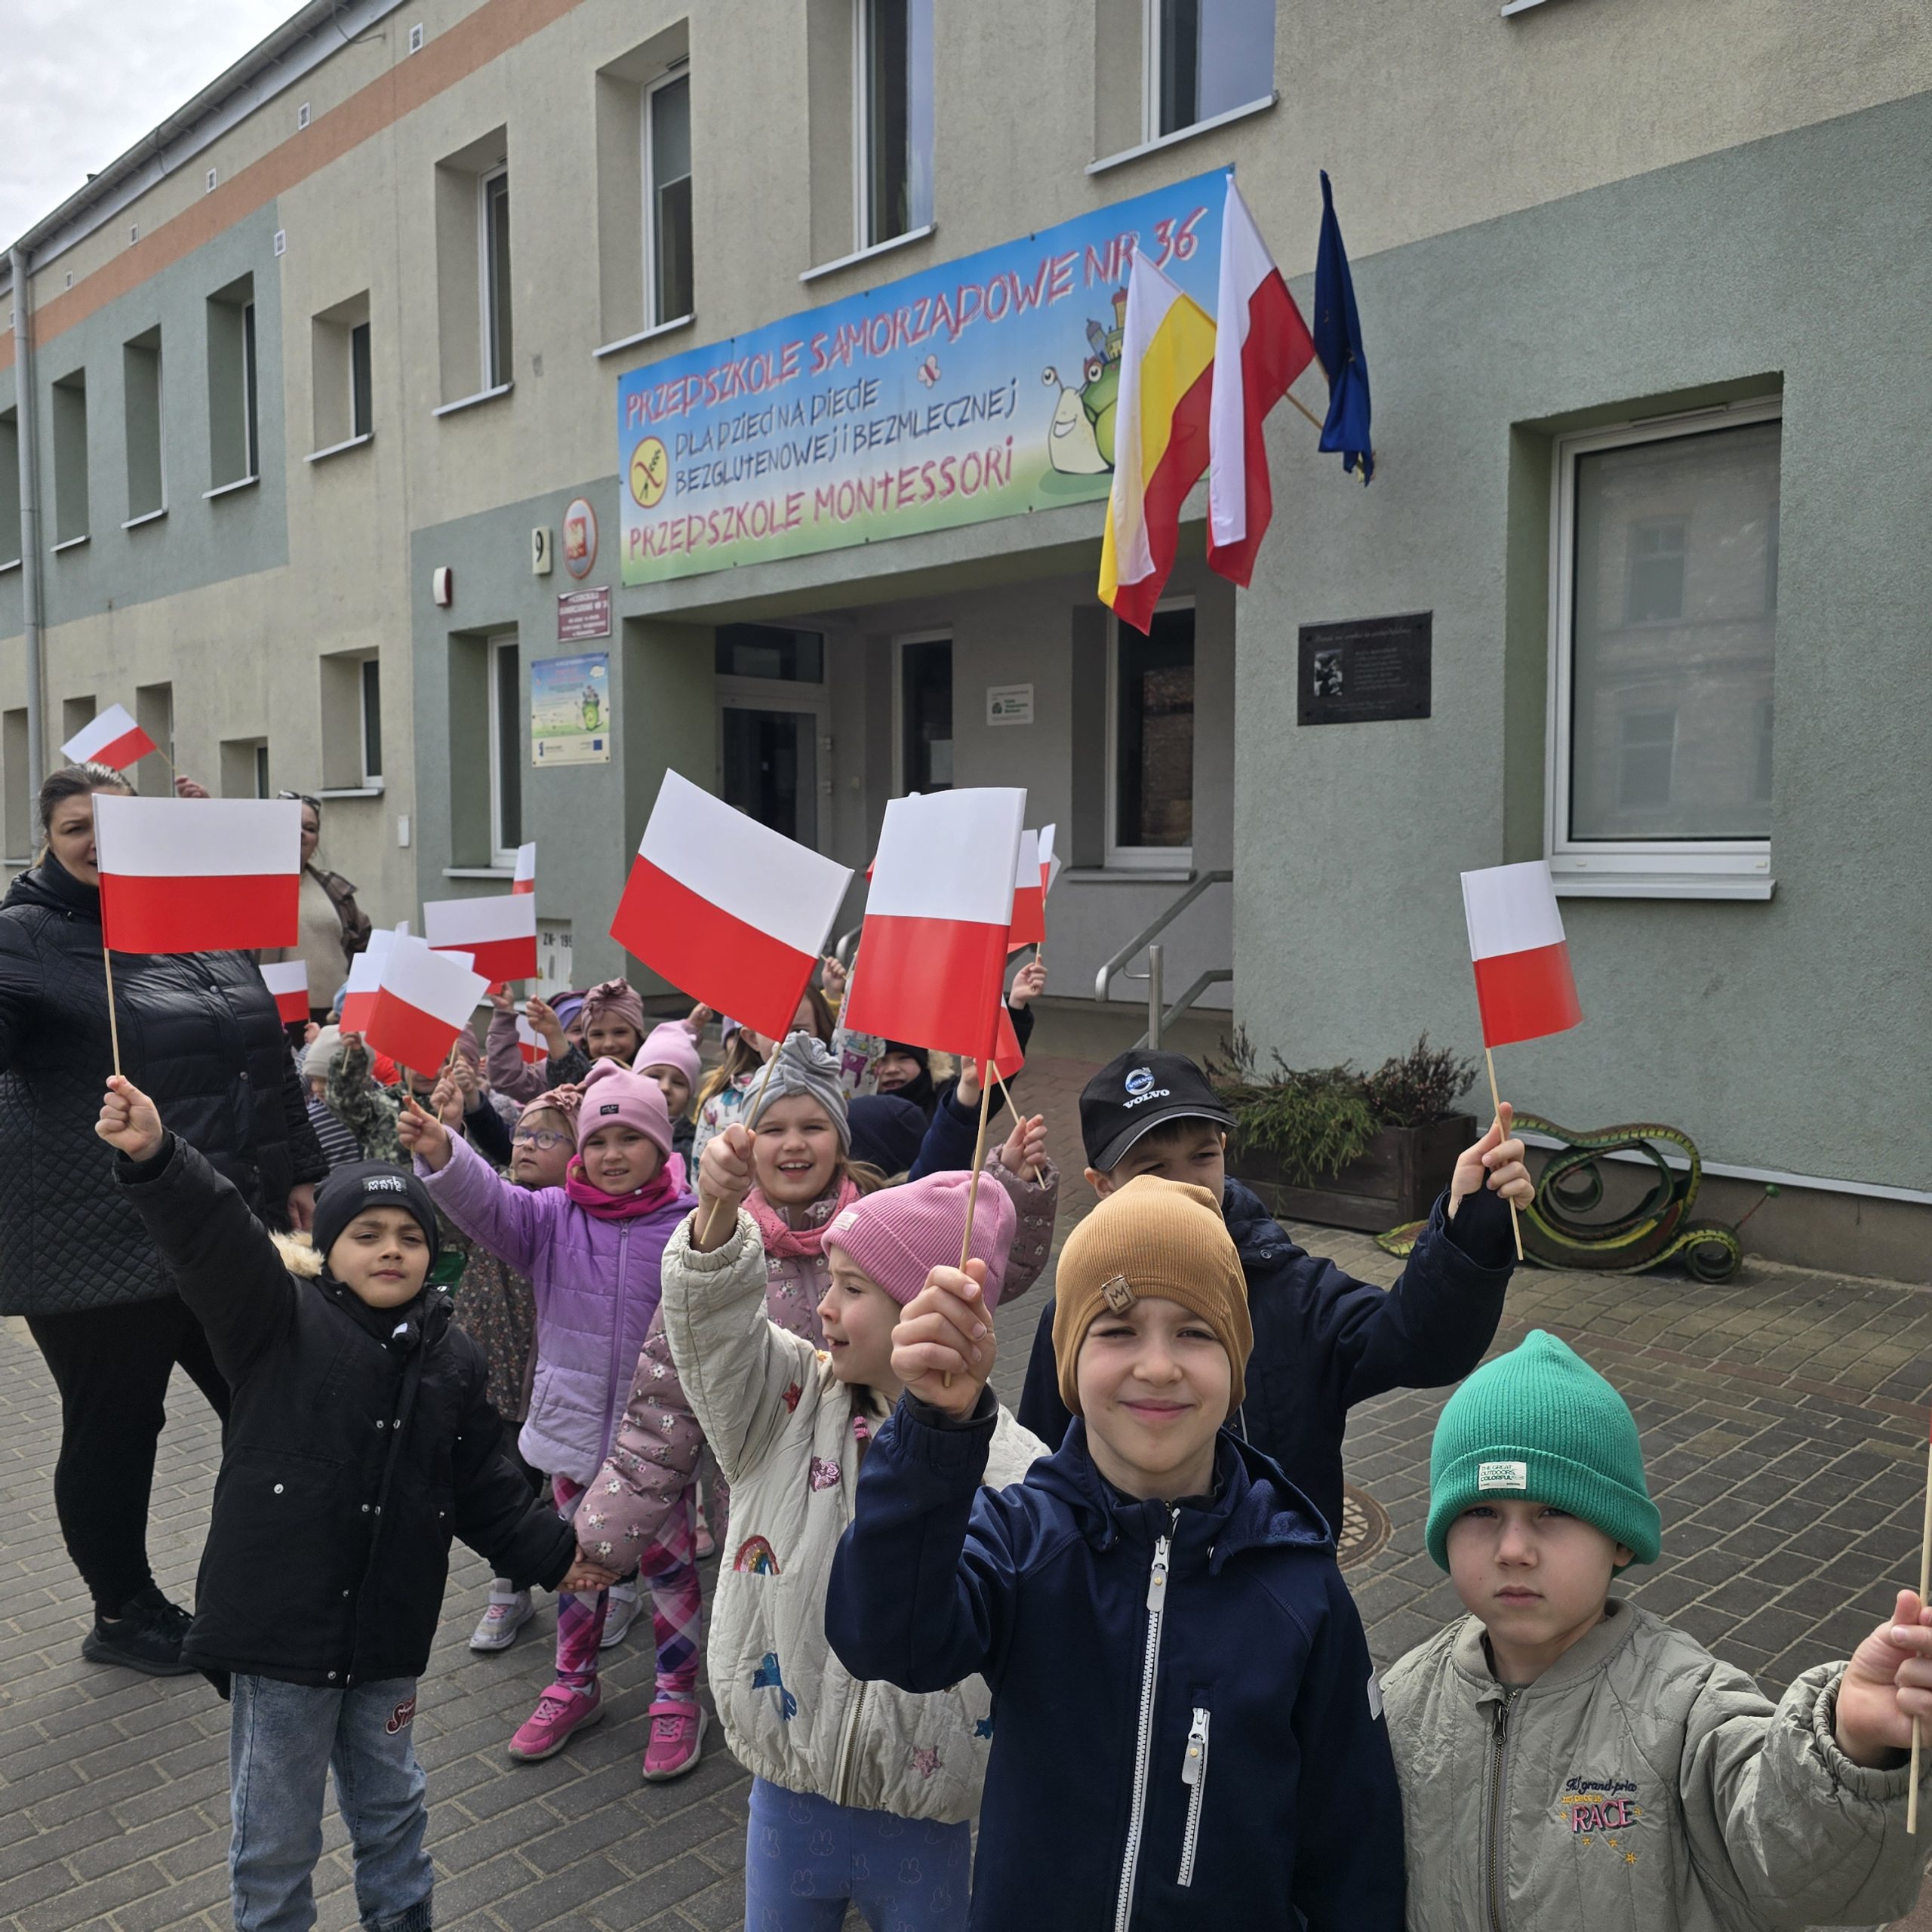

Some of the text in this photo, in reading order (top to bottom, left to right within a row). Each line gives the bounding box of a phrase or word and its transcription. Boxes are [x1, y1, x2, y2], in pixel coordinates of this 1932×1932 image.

[626, 340, 804, 429] PRZEDSZKOLE
[1084, 230, 1140, 289] NR
[1153, 205, 1208, 270] 36
[675, 426, 714, 461] DLA
[777, 398, 805, 428] NA
[629, 491, 806, 561] PRZEDSZKOLE
[535, 531, 544, 563] 9
[1123, 1089, 1170, 1109] VOLVO
[1128, 1075, 1153, 1088] VOLVO
[1572, 1798, 1638, 1834] RACE
